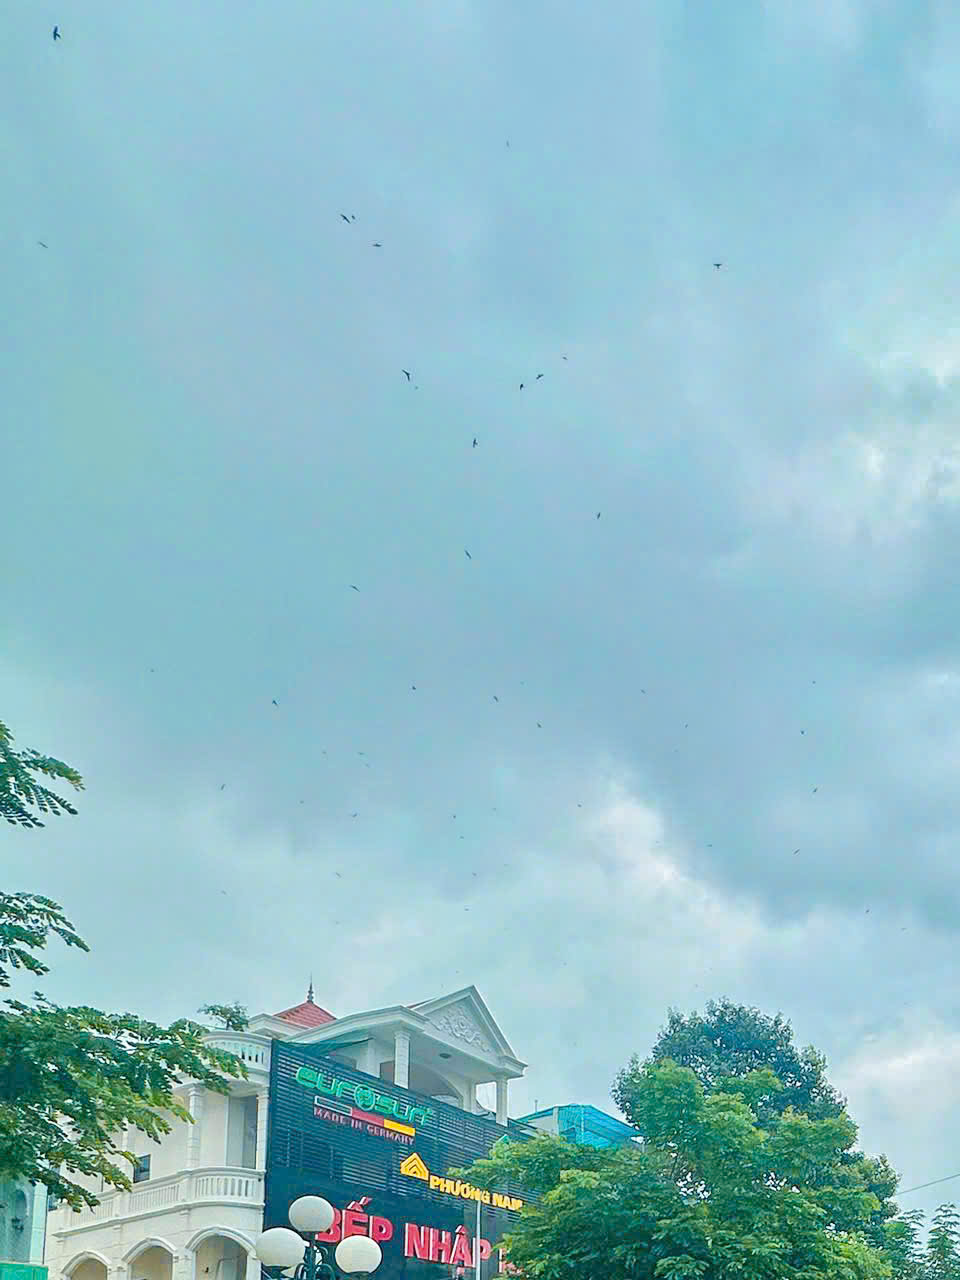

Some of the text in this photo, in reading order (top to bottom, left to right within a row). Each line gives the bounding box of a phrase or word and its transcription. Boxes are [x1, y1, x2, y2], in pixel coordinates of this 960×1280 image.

[314, 1107, 415, 1146] MADE IN GERMANY
[429, 1174, 491, 1204] PHƯƠNG
[404, 1222, 493, 1276] NHẬP
